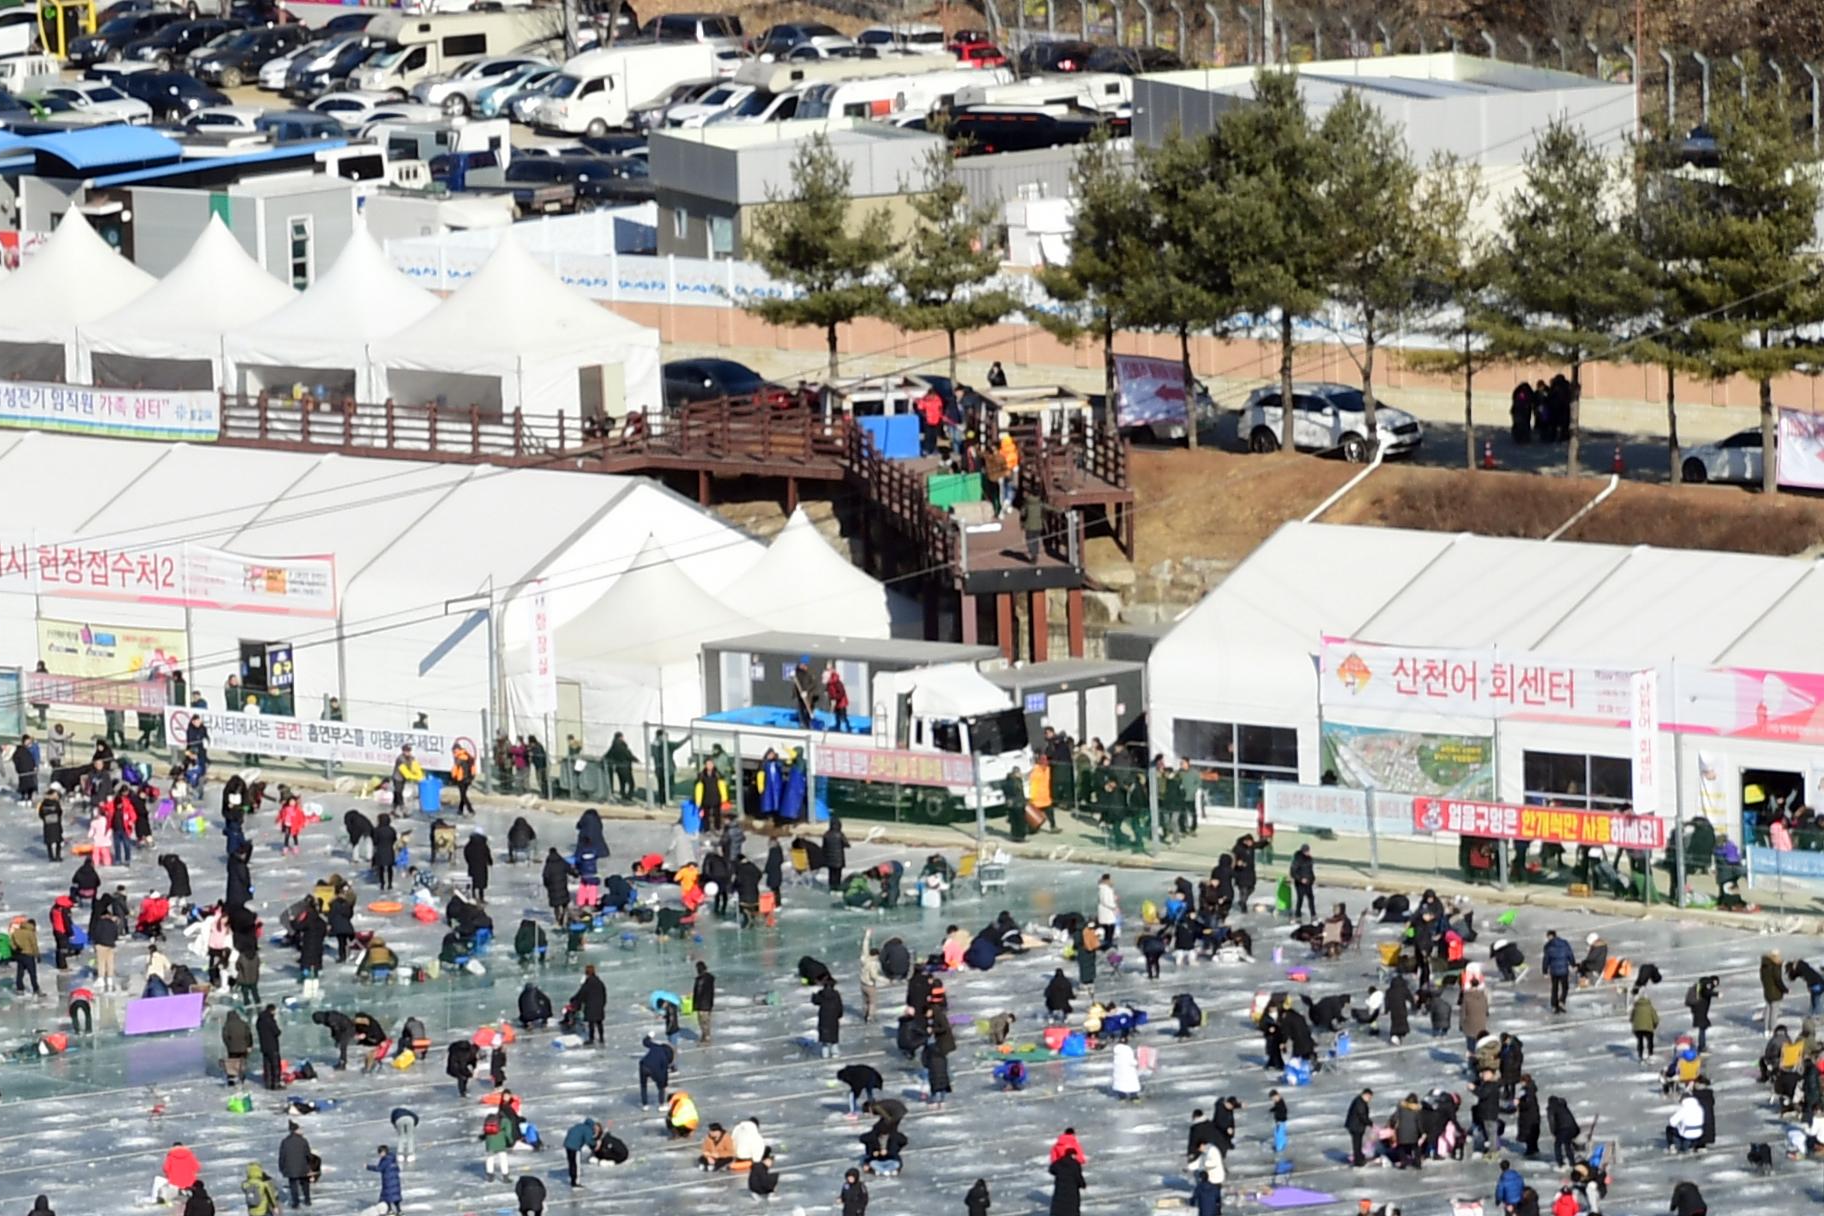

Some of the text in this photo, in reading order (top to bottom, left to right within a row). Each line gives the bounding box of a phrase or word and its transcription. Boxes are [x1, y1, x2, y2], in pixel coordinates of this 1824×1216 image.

[50, 388, 95, 416] 임직원
[99, 393, 126, 417] 가족
[38, 544, 176, 590] 현장접수처2
[271, 673, 293, 686] EXIT
[1391, 657, 1575, 708] 산천어 회센터
[274, 720, 303, 741] 금연!
[307, 723, 364, 748] 흡연부스를
[1448, 801, 1518, 835] 얼음구멍은
